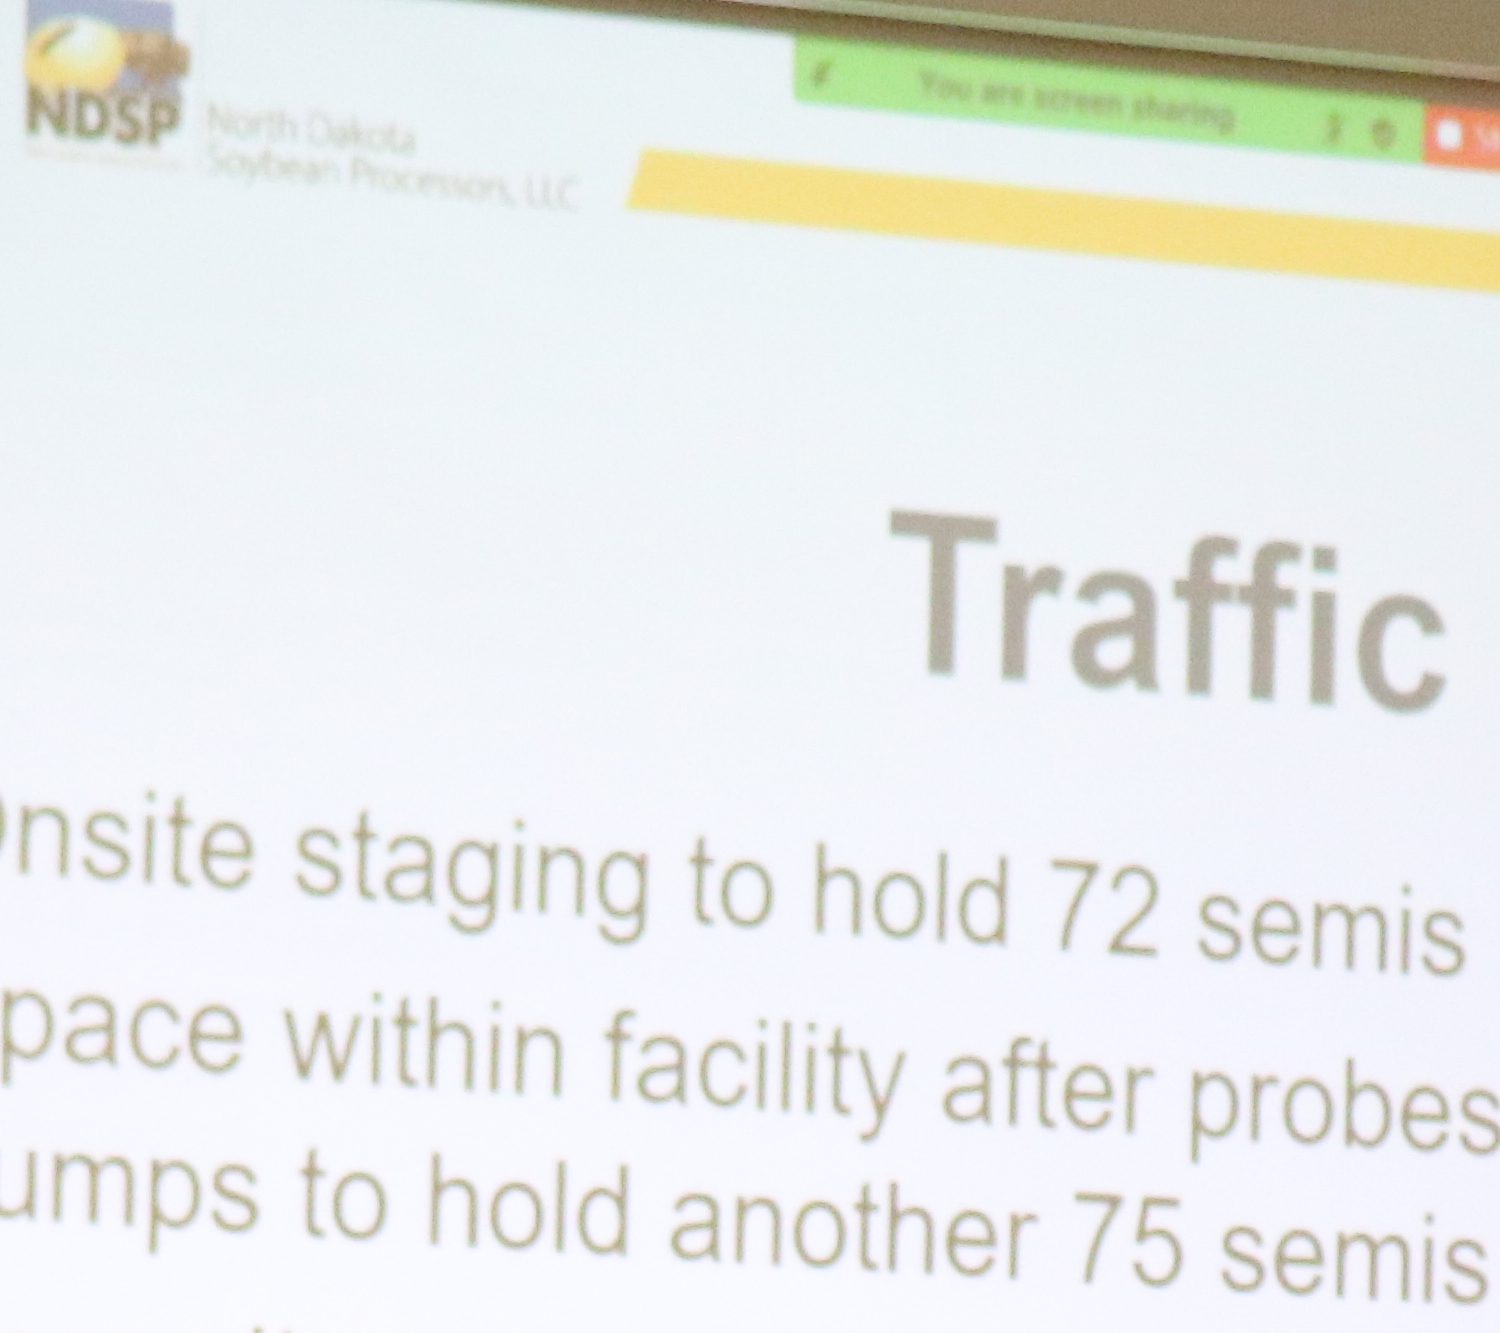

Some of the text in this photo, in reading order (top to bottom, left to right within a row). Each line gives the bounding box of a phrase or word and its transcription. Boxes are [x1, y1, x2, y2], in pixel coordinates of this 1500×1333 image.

[23, 86, 181, 147] NDSP
[205, 101, 418, 158] North Dakota
[919, 68, 1236, 137] You are screen sharing
[205, 138, 342, 189] Soybean
[523, 172, 582, 214] LLC
[886, 507, 1449, 719] Traffic
[294, 810, 651, 949] staging
[687, 835, 777, 932] to
[812, 841, 1011, 948] hold
[1049, 856, 1162, 960] 72
[1196, 891, 1469, 980] semis
[281, 991, 566, 1098] within
[602, 1006, 908, 1146] facility
[939, 1033, 1156, 1135] after
[298, 1147, 390, 1244] to
[427, 1151, 632, 1258] hold
[667, 1180, 1040, 1281] another
[1072, 1189, 1187, 1291] 75
[1219, 1222, 1492, 1308] semis
